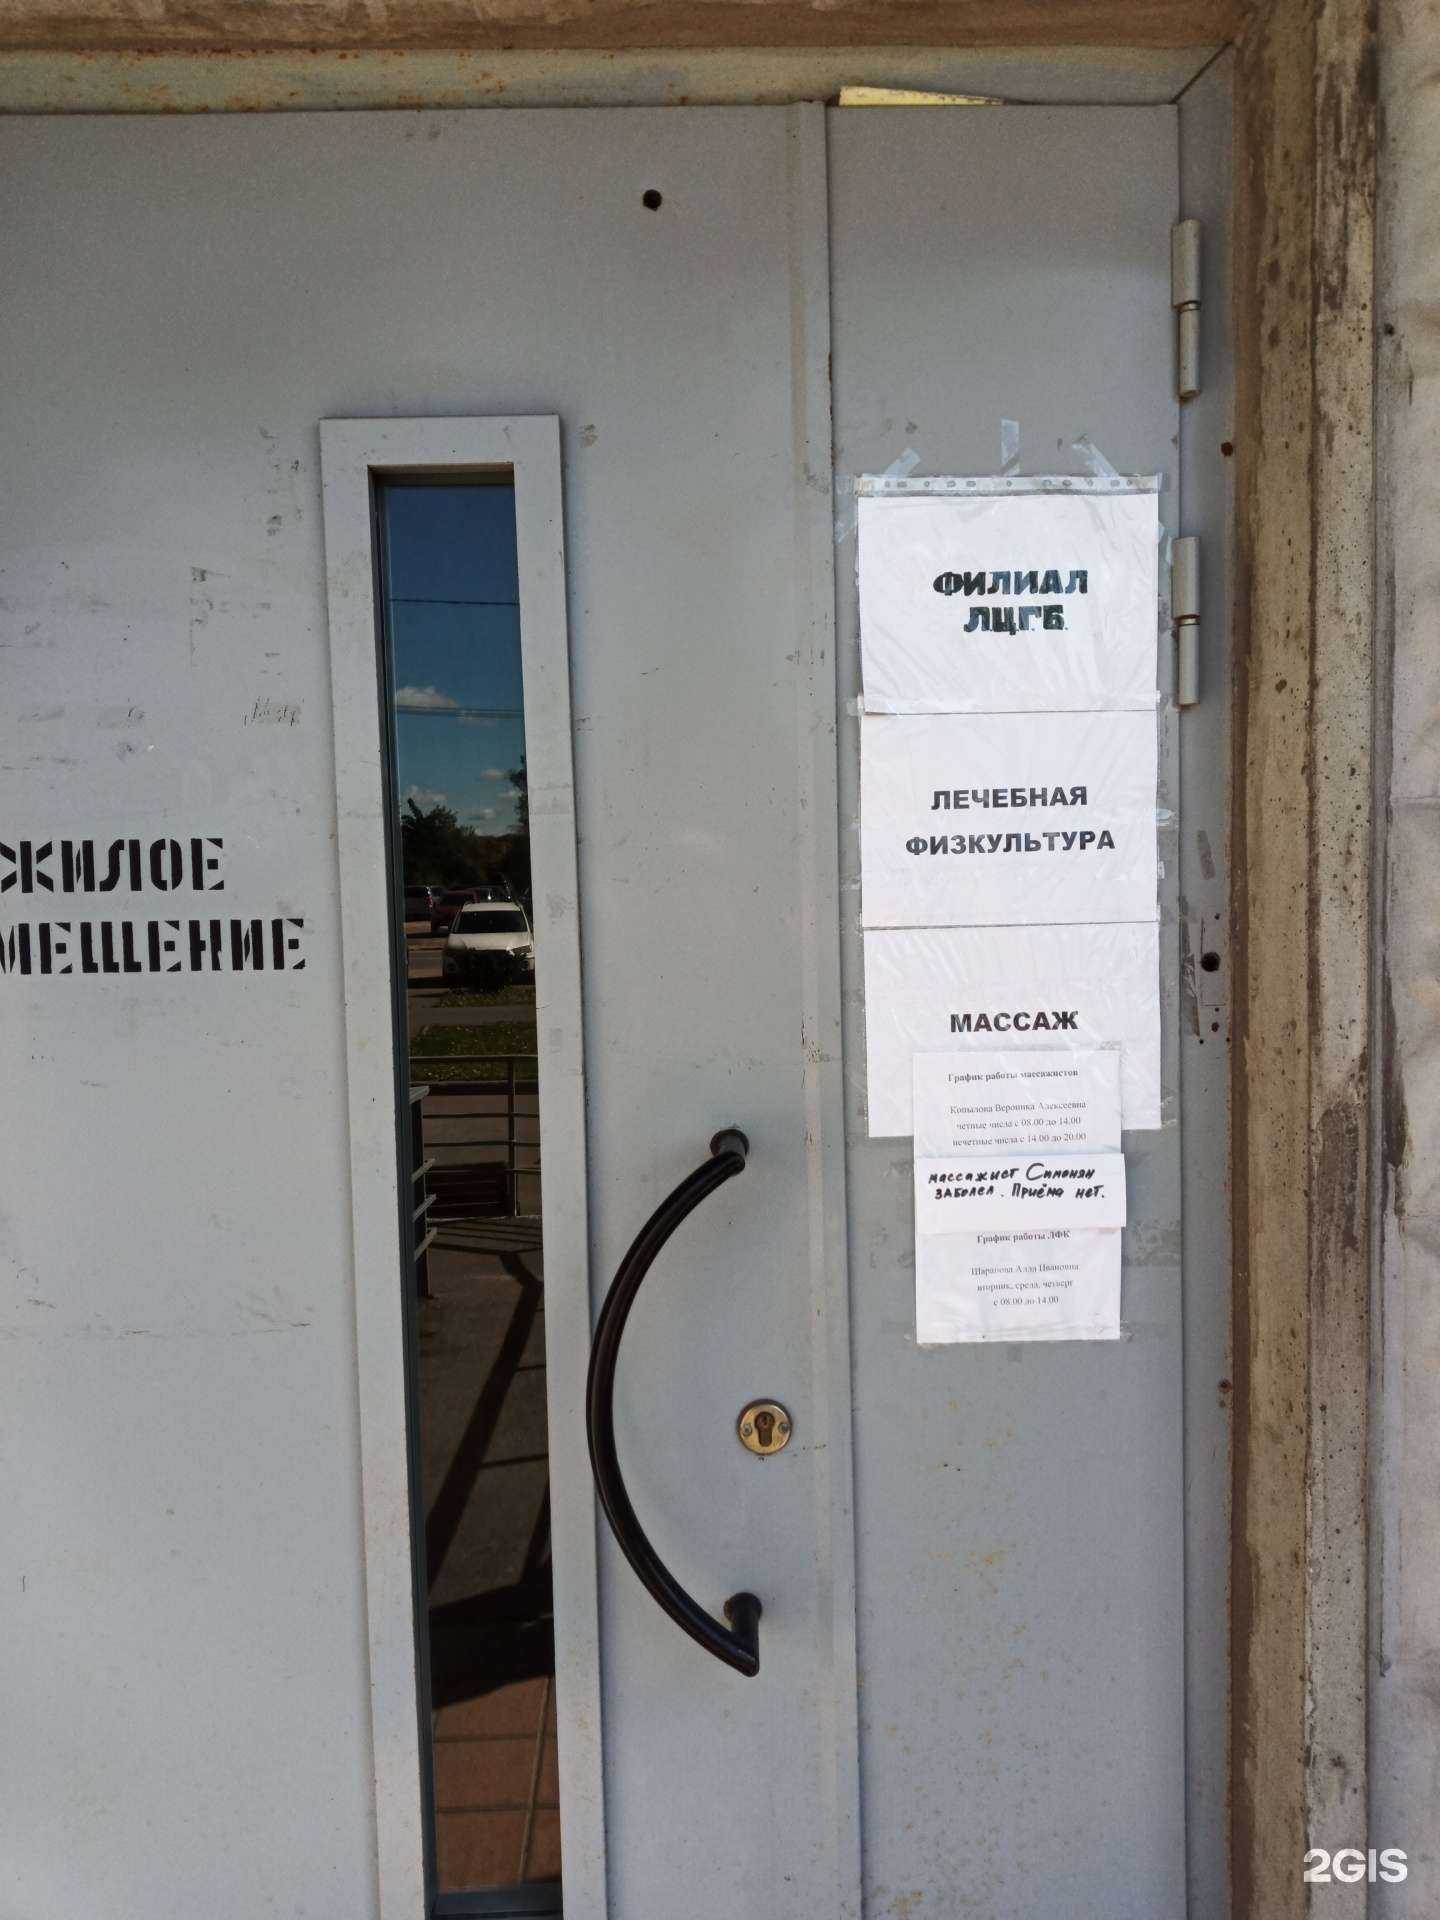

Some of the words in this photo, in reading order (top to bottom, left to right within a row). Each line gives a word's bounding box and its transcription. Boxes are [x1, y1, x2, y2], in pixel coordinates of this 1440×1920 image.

[933, 570, 1088, 596] ФИЛИАЛ
[931, 786, 1088, 810] ЛЕЧЕБНАЯ
[905, 830, 1115, 855] ФИЗКУЛЬТУРА
[0, 838, 225, 893] ЖИЛОЕ
[950, 1010, 1079, 1033] МАССАЖ
[948, 1073, 984, 1084] График
[985, 1071, 1018, 1083] работы
[1019, 1069, 1079, 1079] массажистов
[995, 1103, 1035, 1114] Вероника
[1037, 1101, 1087, 1111] Алексеевна
[989, 1121, 1013, 1130] числа
[1021, 1118, 1044, 1127] 08.00
[1046, 1119, 1057, 1127] до
[1059, 1116, 1082, 1126] 14.00
[994, 1136, 1018, 1145] числа
[1027, 1134, 1050, 1143] 14.00
[1051, 1134, 1062, 1142] до
[1064, 1132, 1087, 1142] 20.00
[977, 1234, 1011, 1245] График
[1013, 1232, 1046, 1244] работы
[1048, 1230, 1072, 1240] ЛФК
[1039, 1263, 1080, 1273] Ивановна
[1000, 1297, 1023, 1306] 08.00
[1037, 1296, 1060, 1305] 14.00
